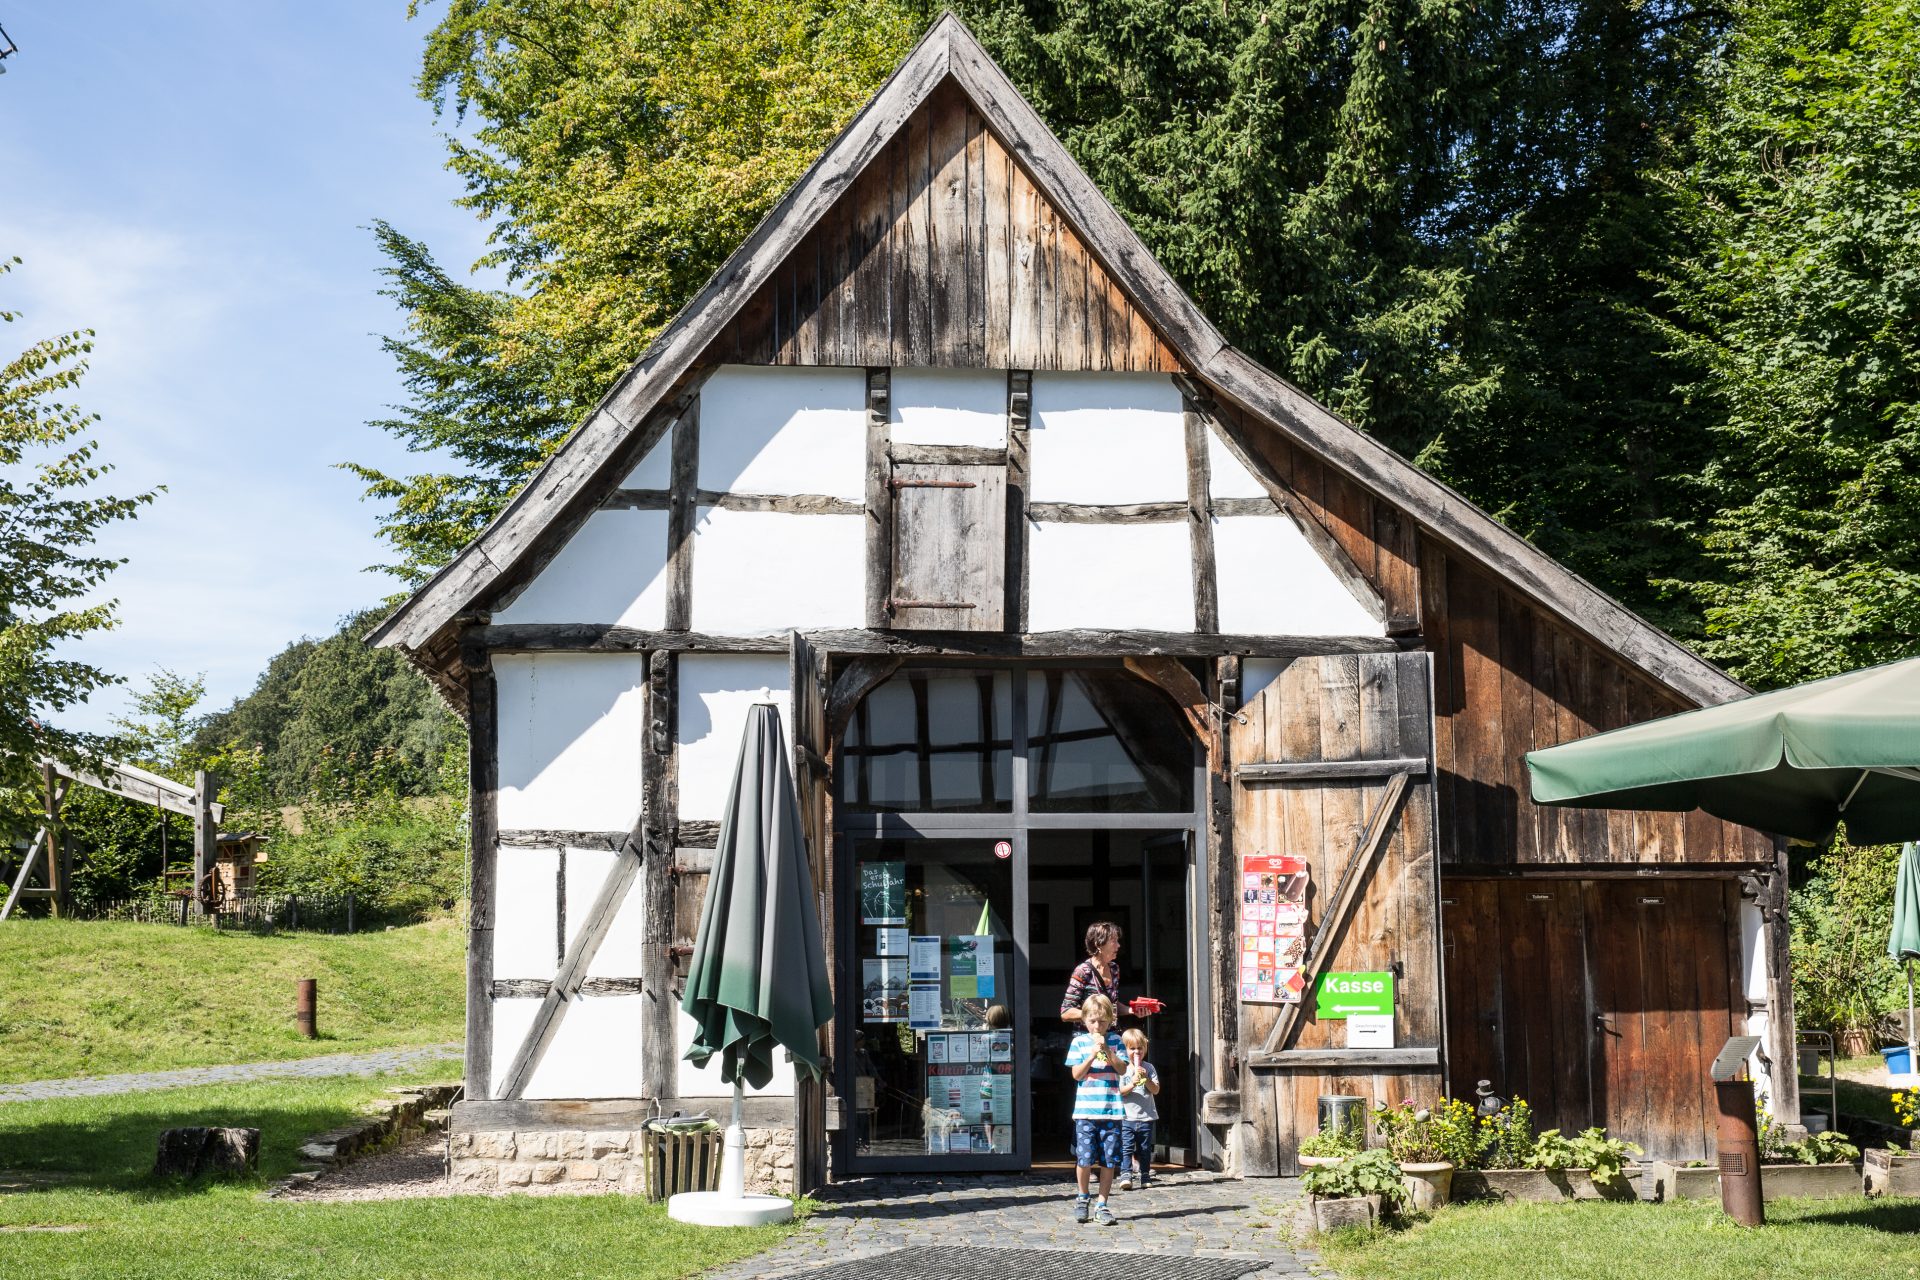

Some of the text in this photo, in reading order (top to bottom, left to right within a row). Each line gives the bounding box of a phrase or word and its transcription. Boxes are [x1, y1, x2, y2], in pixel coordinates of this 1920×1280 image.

[863, 869, 878, 877] Das
[863, 877, 904, 889] Schuljahr
[1325, 977, 1384, 993] Kasse
